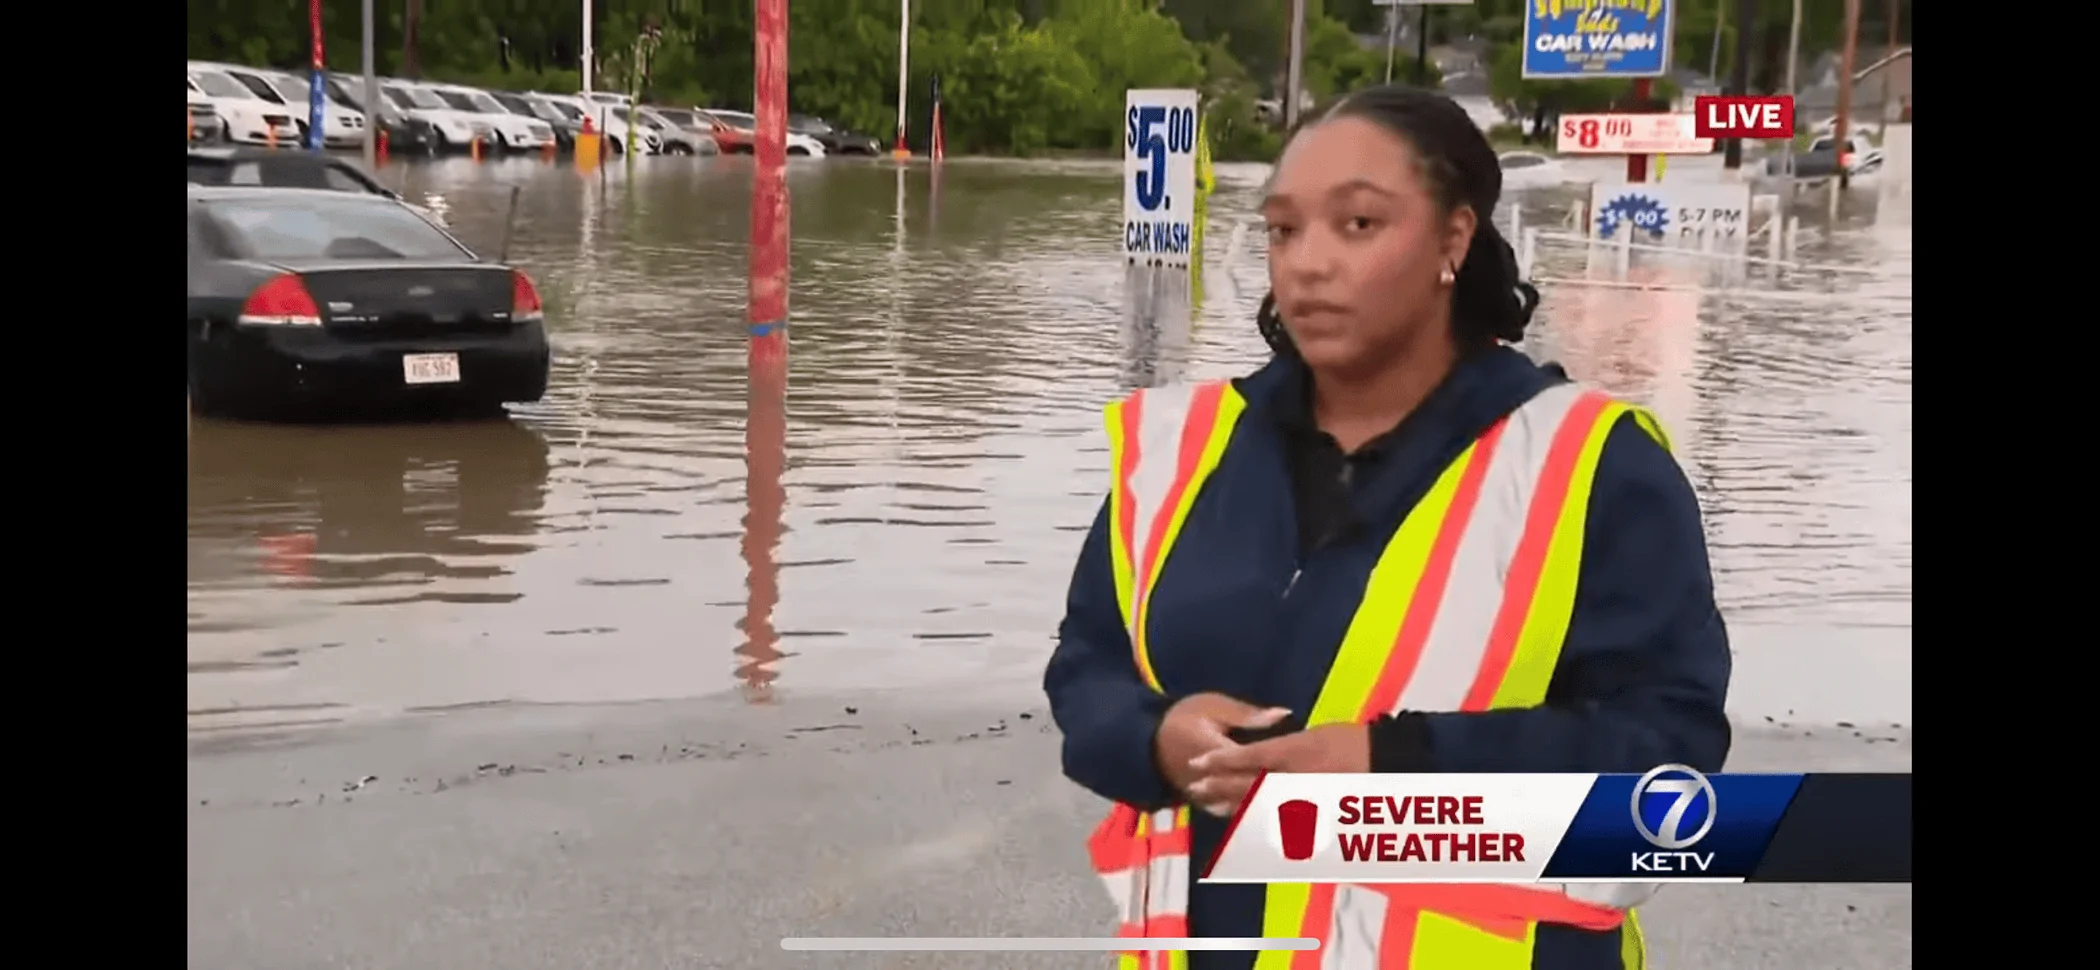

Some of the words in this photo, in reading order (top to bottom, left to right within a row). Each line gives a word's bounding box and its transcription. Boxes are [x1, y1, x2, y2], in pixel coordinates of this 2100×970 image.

[1535, 33, 1582, 52] CAR
[1588, 31, 1657, 51] WASH
[1712, 209, 1741, 223] PM
[1126, 221, 1151, 252] CAR
[1153, 221, 1190, 254] WASH
